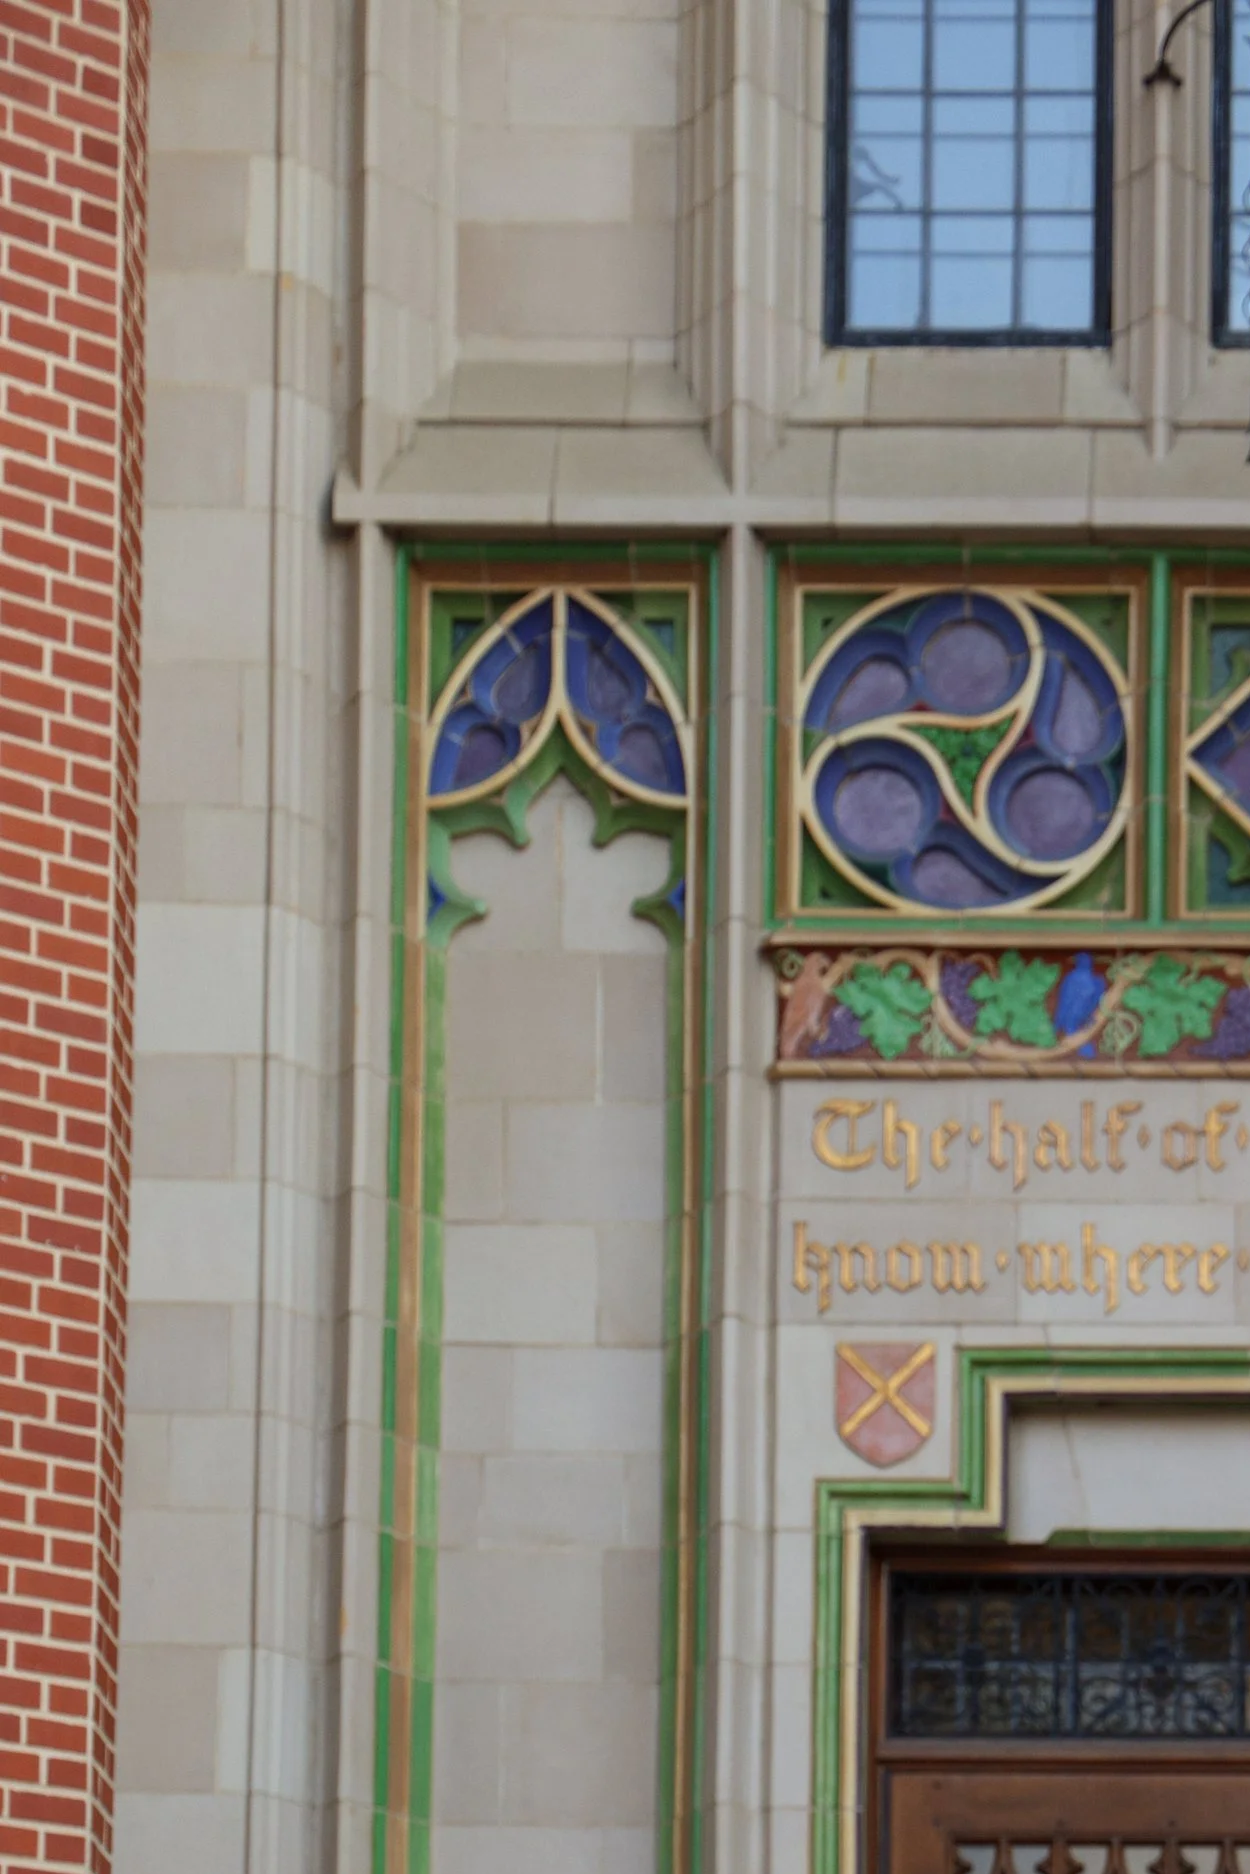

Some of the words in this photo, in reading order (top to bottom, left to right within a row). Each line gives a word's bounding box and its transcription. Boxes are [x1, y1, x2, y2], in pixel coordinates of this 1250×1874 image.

[812, 1098, 961, 1190] The
[987, 1099, 1142, 1191] half
[1161, 1100, 1240, 1172] of
[792, 1220, 986, 1315] know
[1018, 1222, 1230, 1315] where
